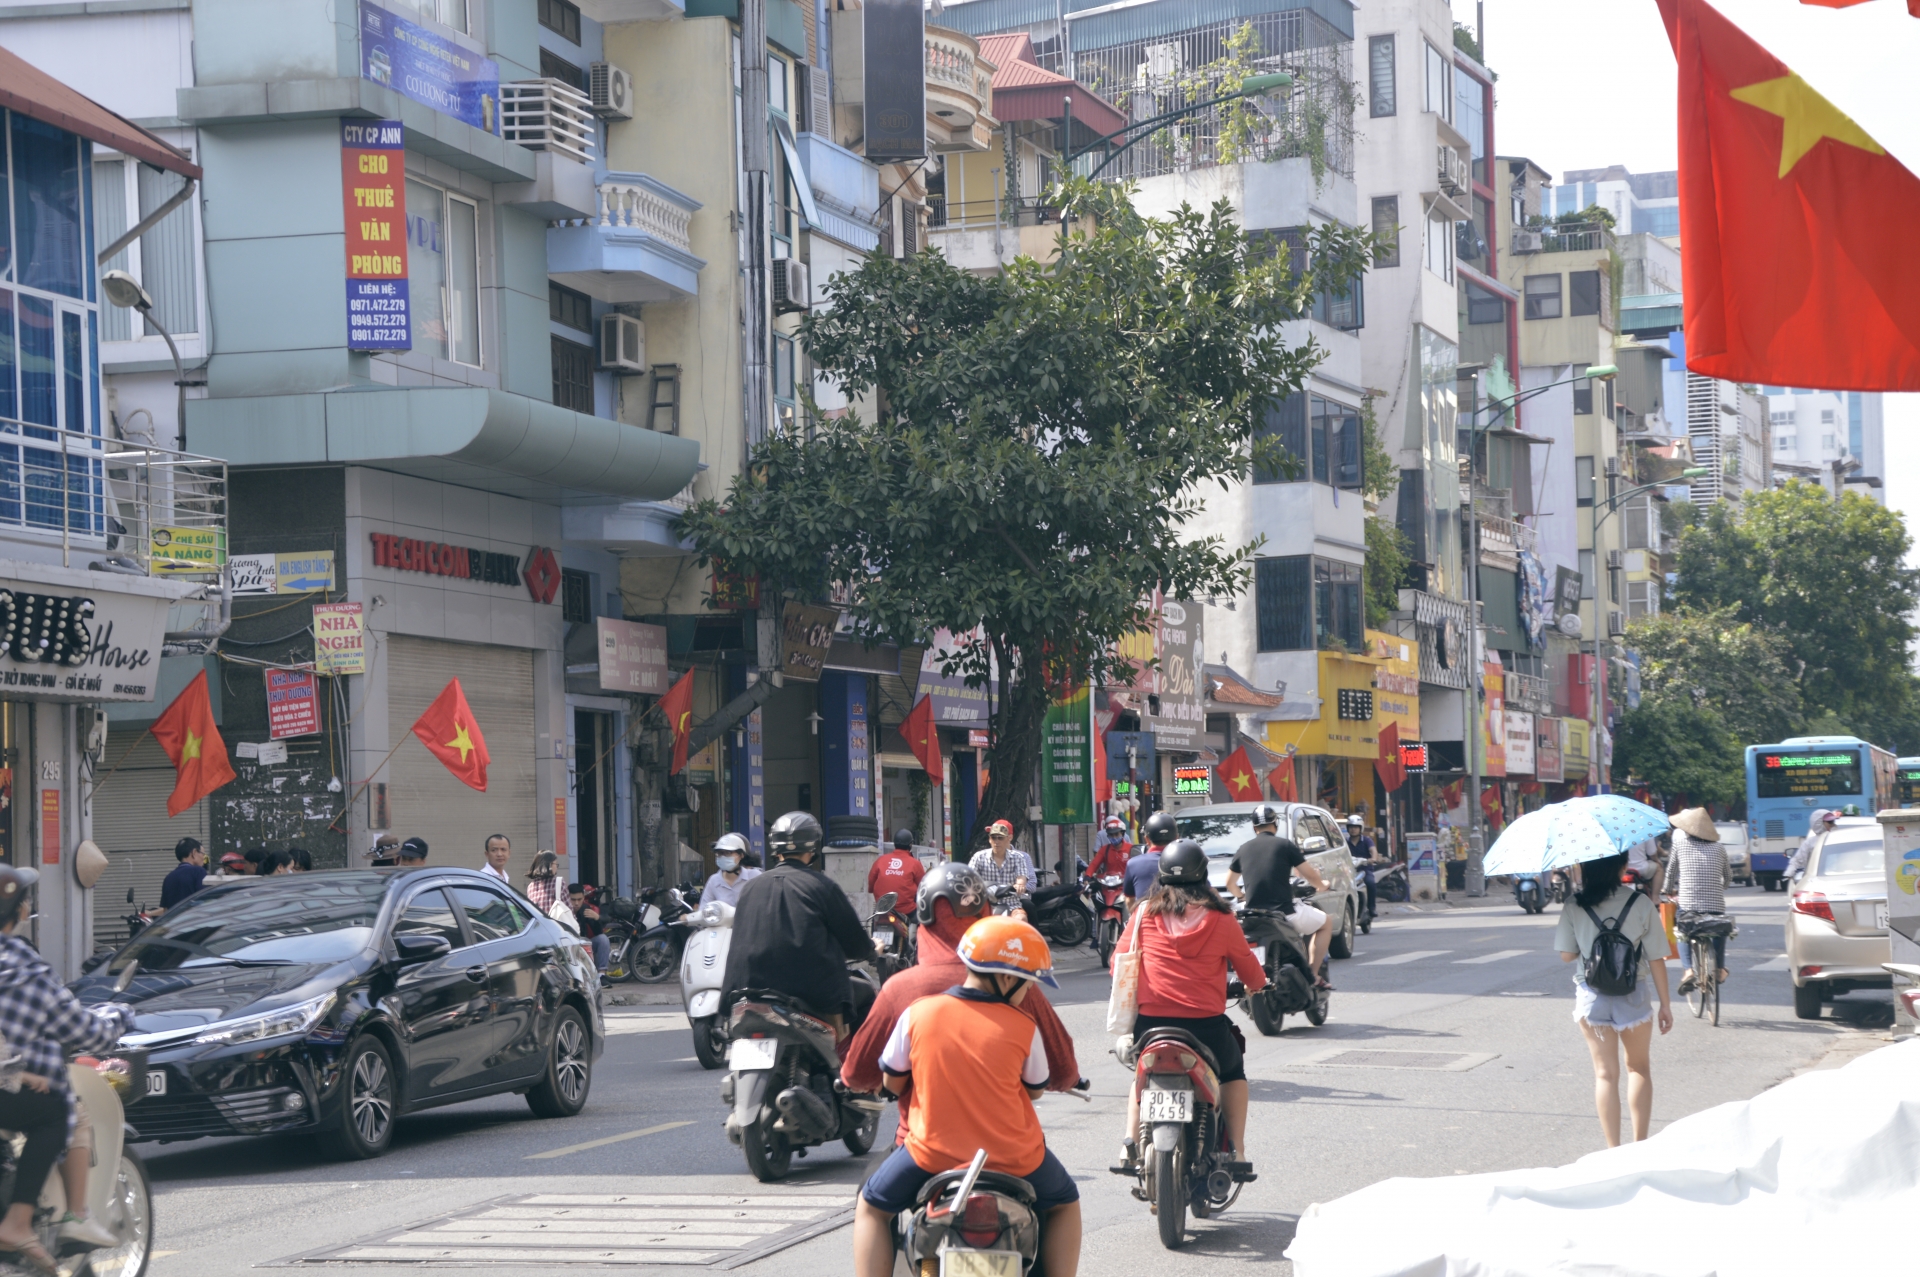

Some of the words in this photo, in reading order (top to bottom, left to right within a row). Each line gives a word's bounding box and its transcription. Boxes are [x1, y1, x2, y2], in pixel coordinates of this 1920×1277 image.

[879, 114, 908, 128] 301
[345, 125, 363, 143] CTY
[366, 127, 379, 144] CP
[380, 127, 401, 144] ANN
[900, 138, 923, 150] MAI
[359, 154, 388, 174] CHO
[354, 184, 394, 207] THUÊ
[360, 218, 390, 241] VĂN
[352, 250, 402, 274] PHÒNG
[359, 283, 379, 294] LIÊN
[381, 283, 396, 296] HỆ:
[351, 299, 406, 311] 0971.472.279
[351, 314, 406, 326] 0949.572.279
[352, 329, 407, 341] 0901.672.279
[279, 561, 290, 575] AHA
[290, 560, 311, 574] ENGLISH
[270, 582, 277, 592] 5
[320, 611, 359, 631] NHÀ
[89, 620, 152, 670] House
[317, 630, 363, 651] NGHỈ
[42, 760, 60, 780] 295
[997, 949, 1029, 963] AhaMove
[1150, 1091, 1186, 1105] 30-K6
[1149, 1105, 1185, 1120] 8459
